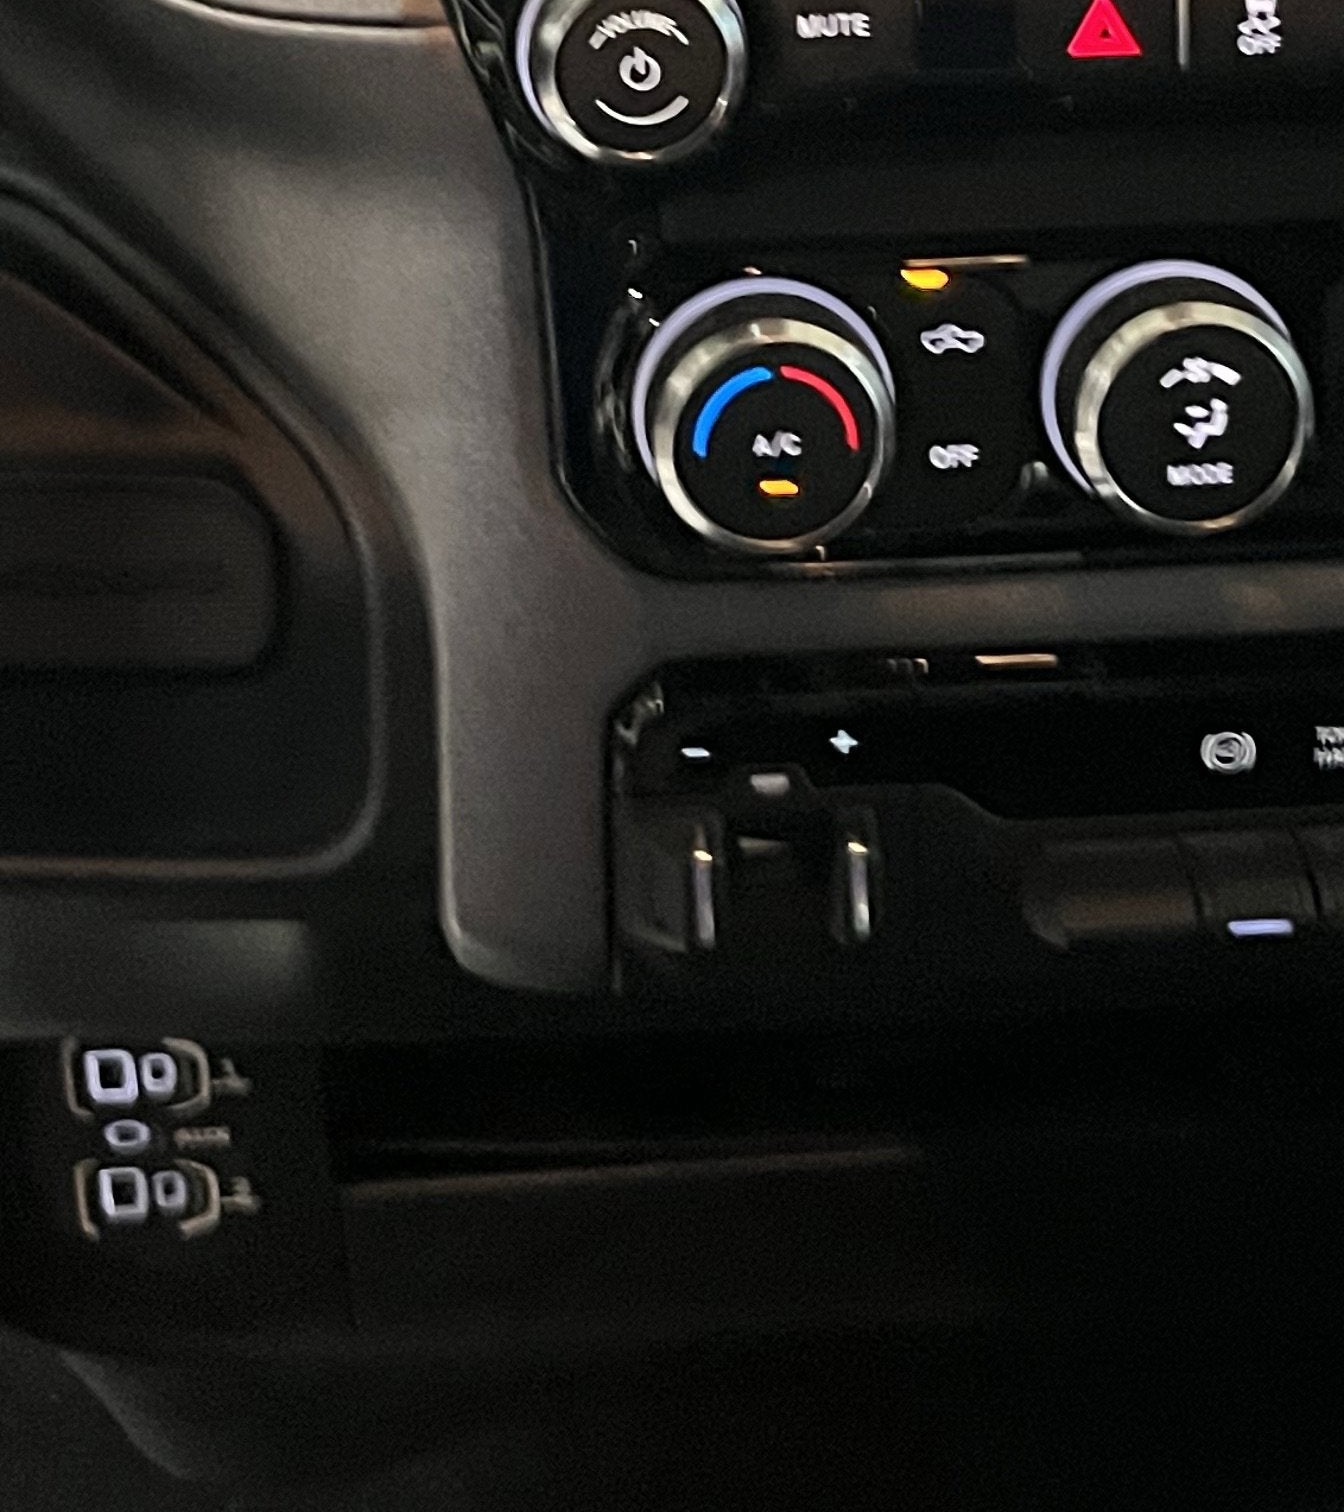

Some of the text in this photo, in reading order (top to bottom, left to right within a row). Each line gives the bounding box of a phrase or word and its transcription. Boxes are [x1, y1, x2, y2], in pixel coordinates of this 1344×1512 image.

[795, 13, 870, 39] MUTE
[752, 430, 803, 458] A/C
[929, 443, 980, 469] OFF
[1167, 461, 1234, 486] MODE
